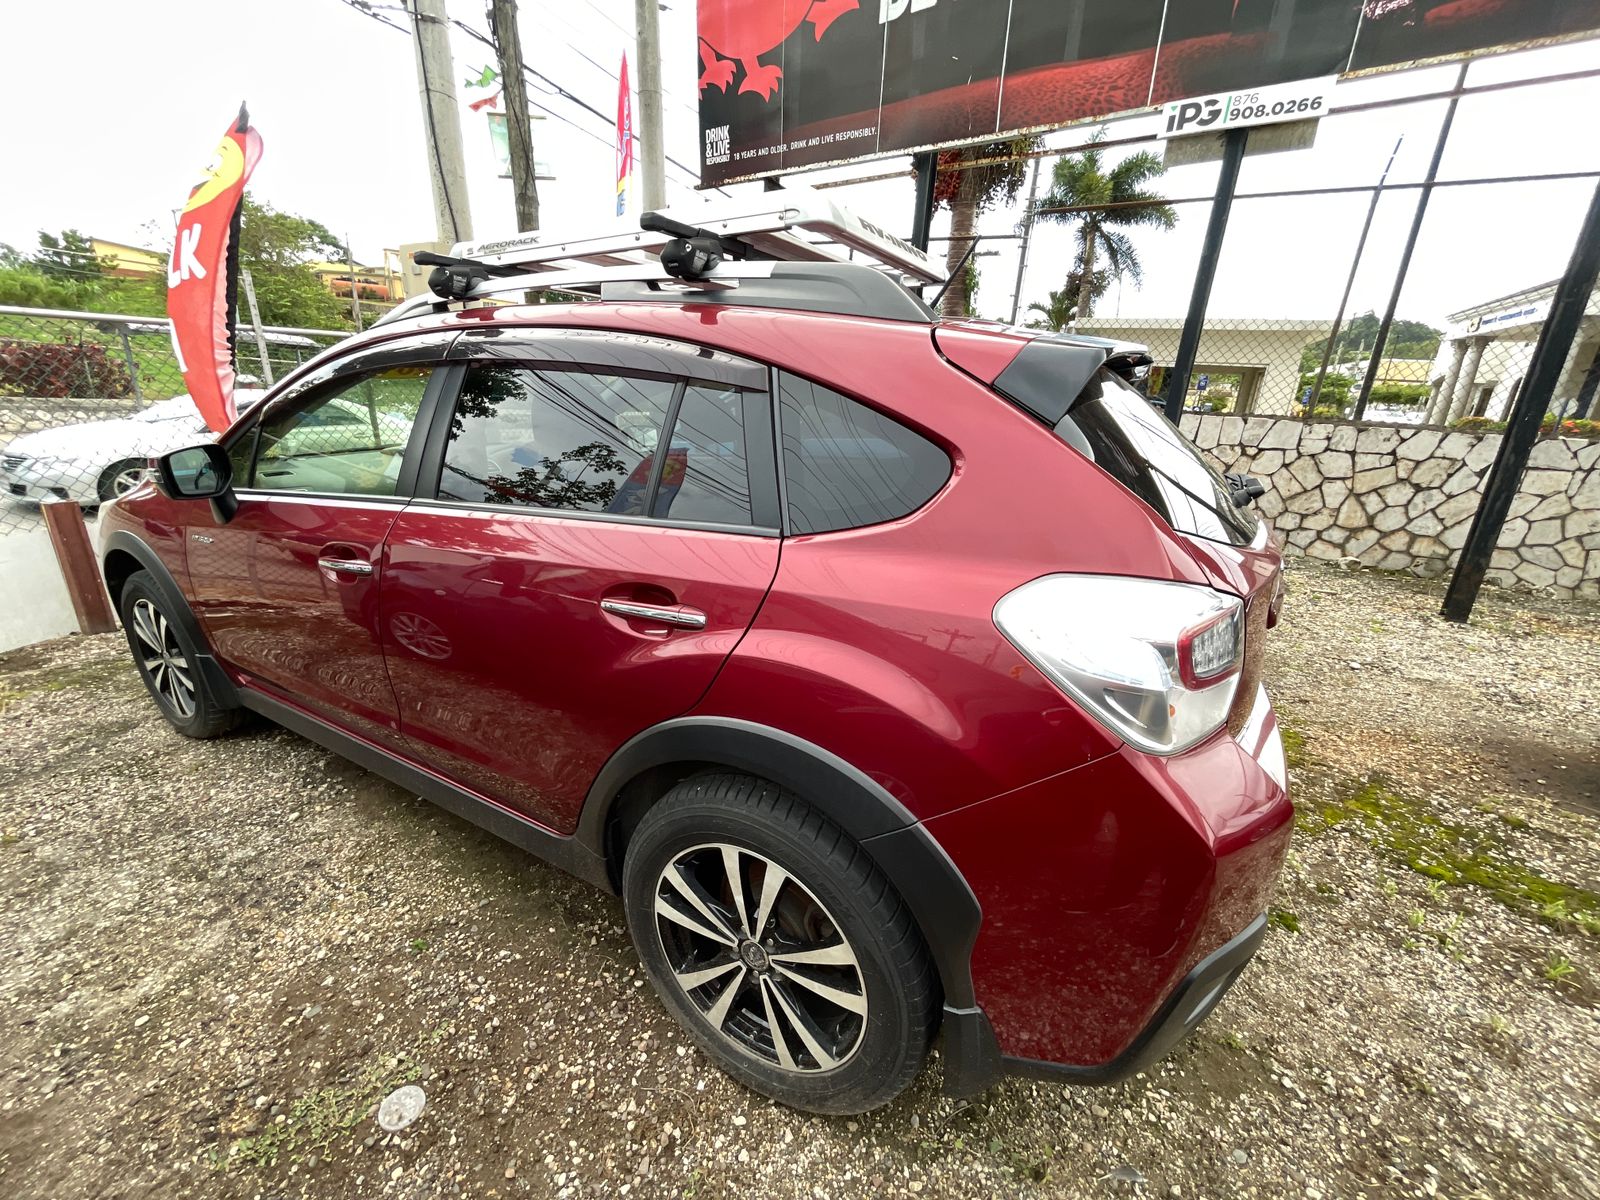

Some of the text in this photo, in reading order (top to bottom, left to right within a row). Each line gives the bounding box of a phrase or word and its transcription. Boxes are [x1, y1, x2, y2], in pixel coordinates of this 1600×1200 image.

[1232, 93, 1259, 106] 876
[1229, 96, 1323, 122] 908.0266
[705, 125, 730, 143] DRINK
[733, 152, 740, 160] 18
[741, 149, 757, 159] YEARS
[758, 147, 769, 156] AND
[790, 139, 807, 150] DRINK
[808, 136, 820, 147] AND
[821, 133, 834, 145] LIVE
[835, 126, 877, 142] RESPONSIBLY.
[705, 139, 730, 158] & LIVE
[706, 154, 730, 165] RESPONSIBLY
[477, 236, 540, 251] AERORACK
